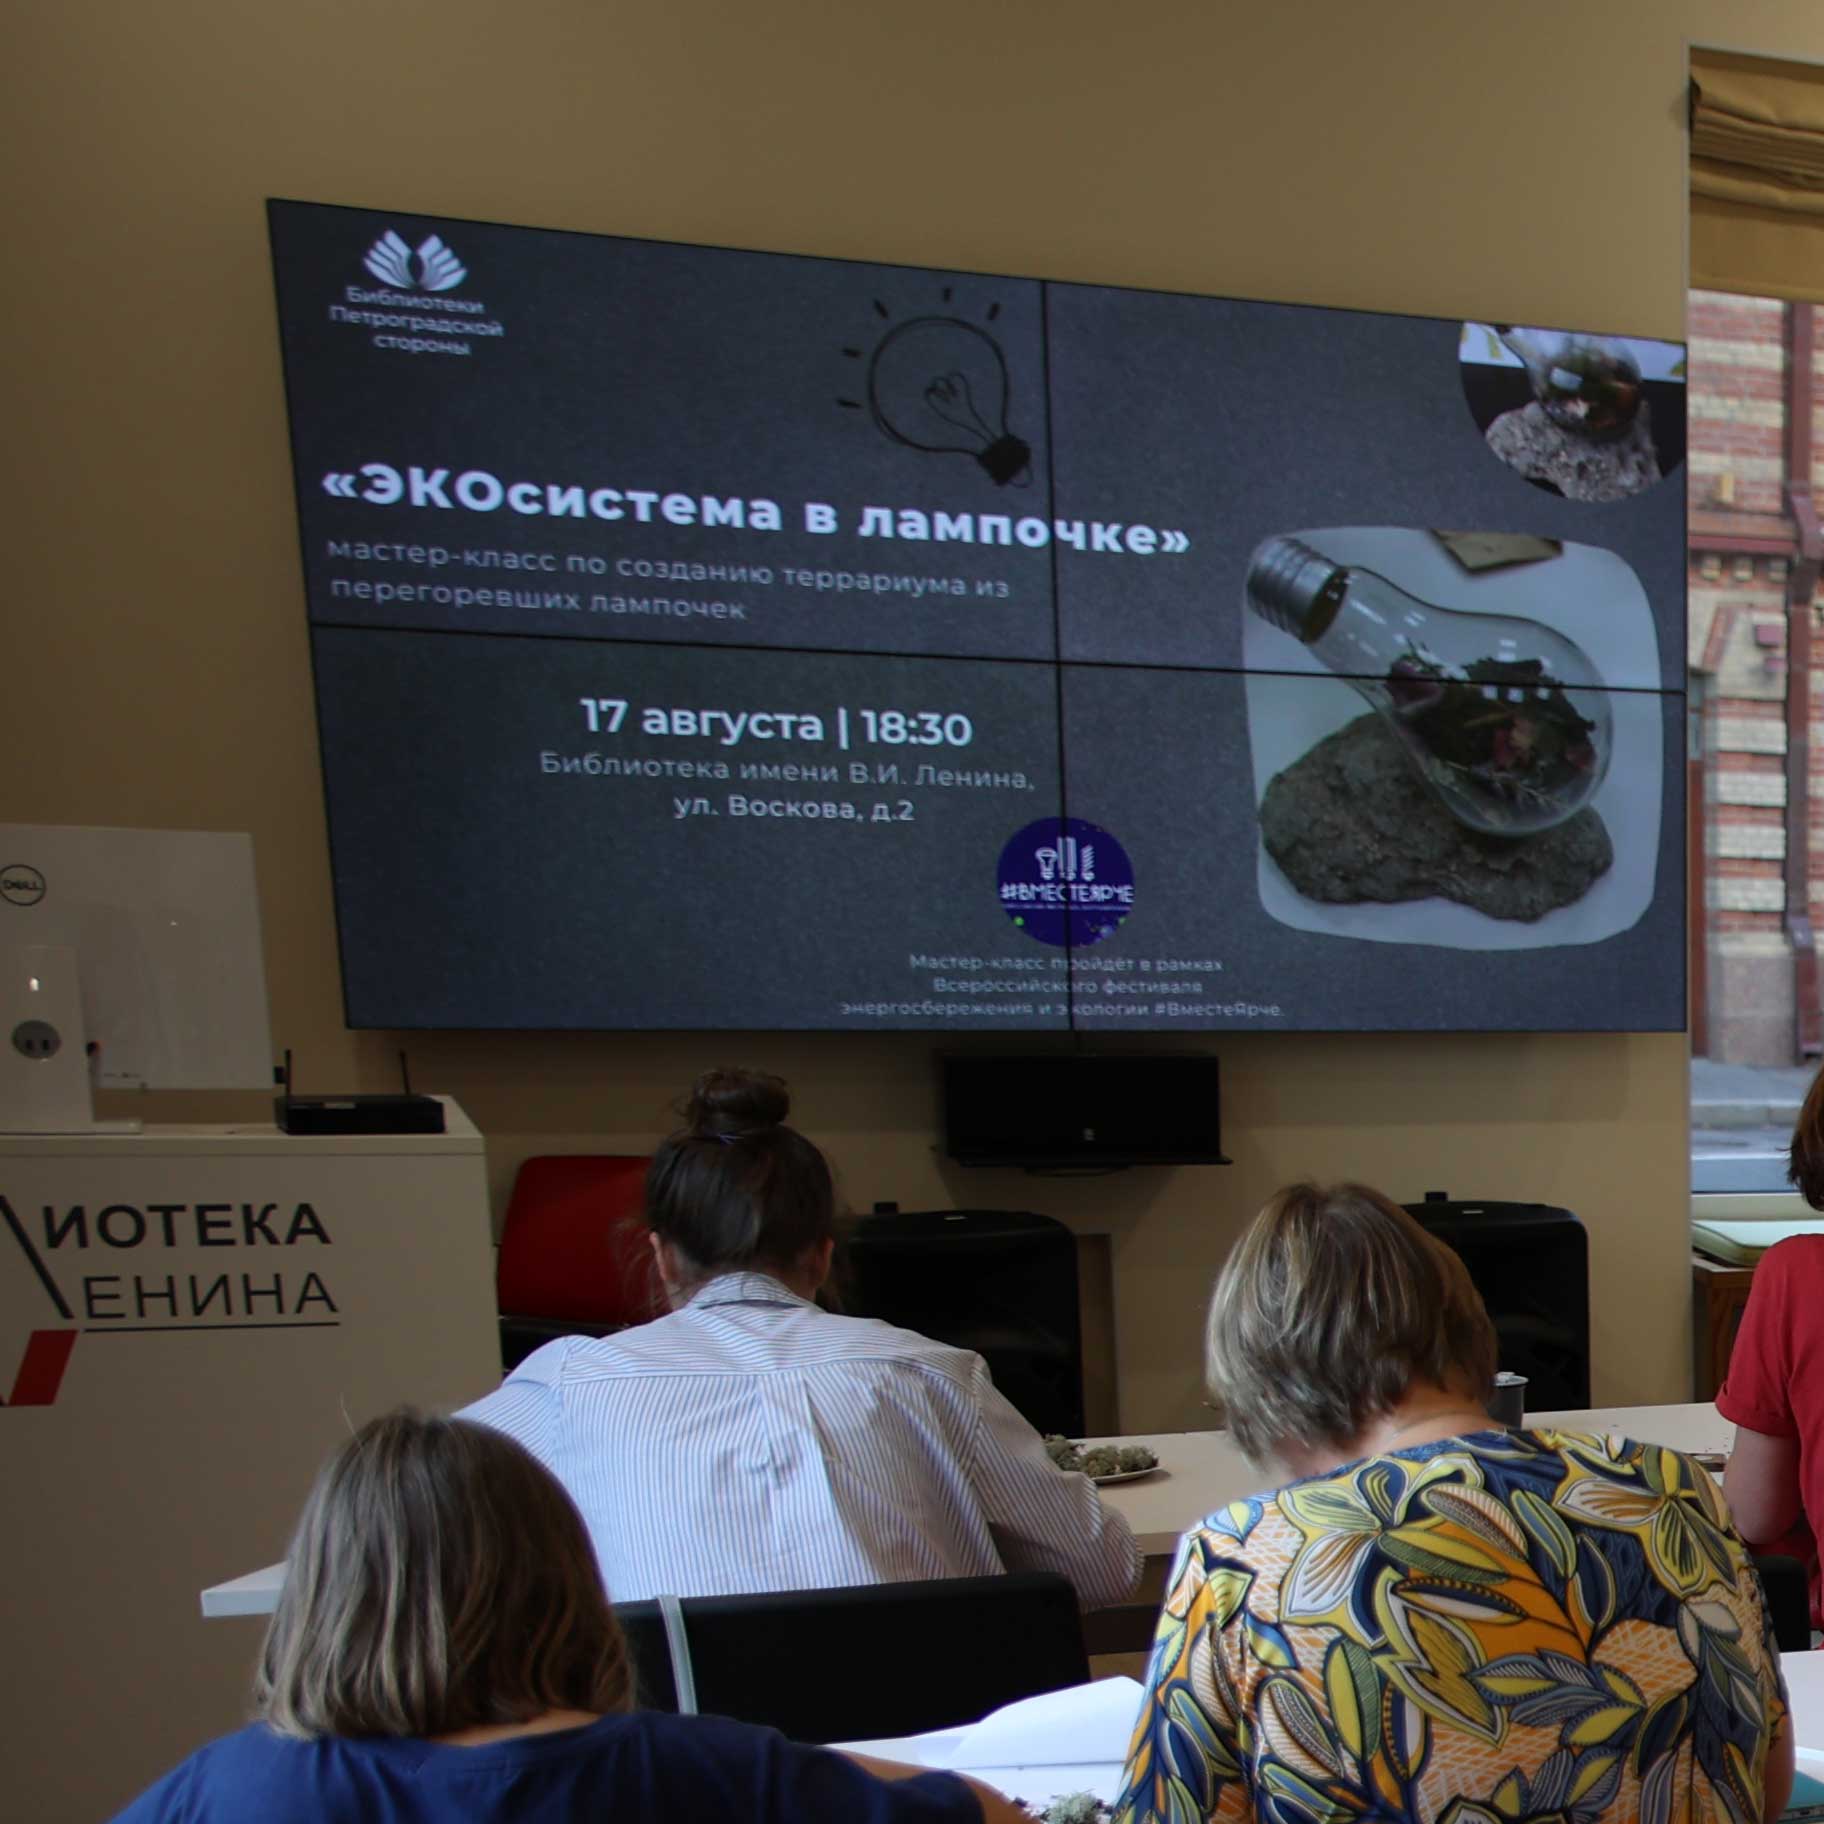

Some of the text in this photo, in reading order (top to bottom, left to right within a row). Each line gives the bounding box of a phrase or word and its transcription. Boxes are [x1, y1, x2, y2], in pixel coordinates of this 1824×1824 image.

[328, 303, 505, 337] Петроградской
[346, 285, 485, 314] Библиотеки
[374, 334, 472, 355] стороны
[322, 463, 1191, 555] «ЭКОсистема в лампочке»
[327, 539, 1010, 599] мастер-класс по созданию террариума из
[331, 578, 747, 621] перегоревших лампочек
[580, 698, 629, 734] 17
[642, 704, 824, 746] августа
[860, 709, 974, 747] 18:30
[540, 750, 1036, 793] Библиотека имени В.И. Ленина,
[673, 797, 720, 819] ул.
[728, 795, 864, 822] Воскова,
[909, 953, 1046, 973] Мастер-класс
[43, 1203, 332, 1249] ИОТЕКА
[83, 1271, 339, 1320] ЕНИНА
